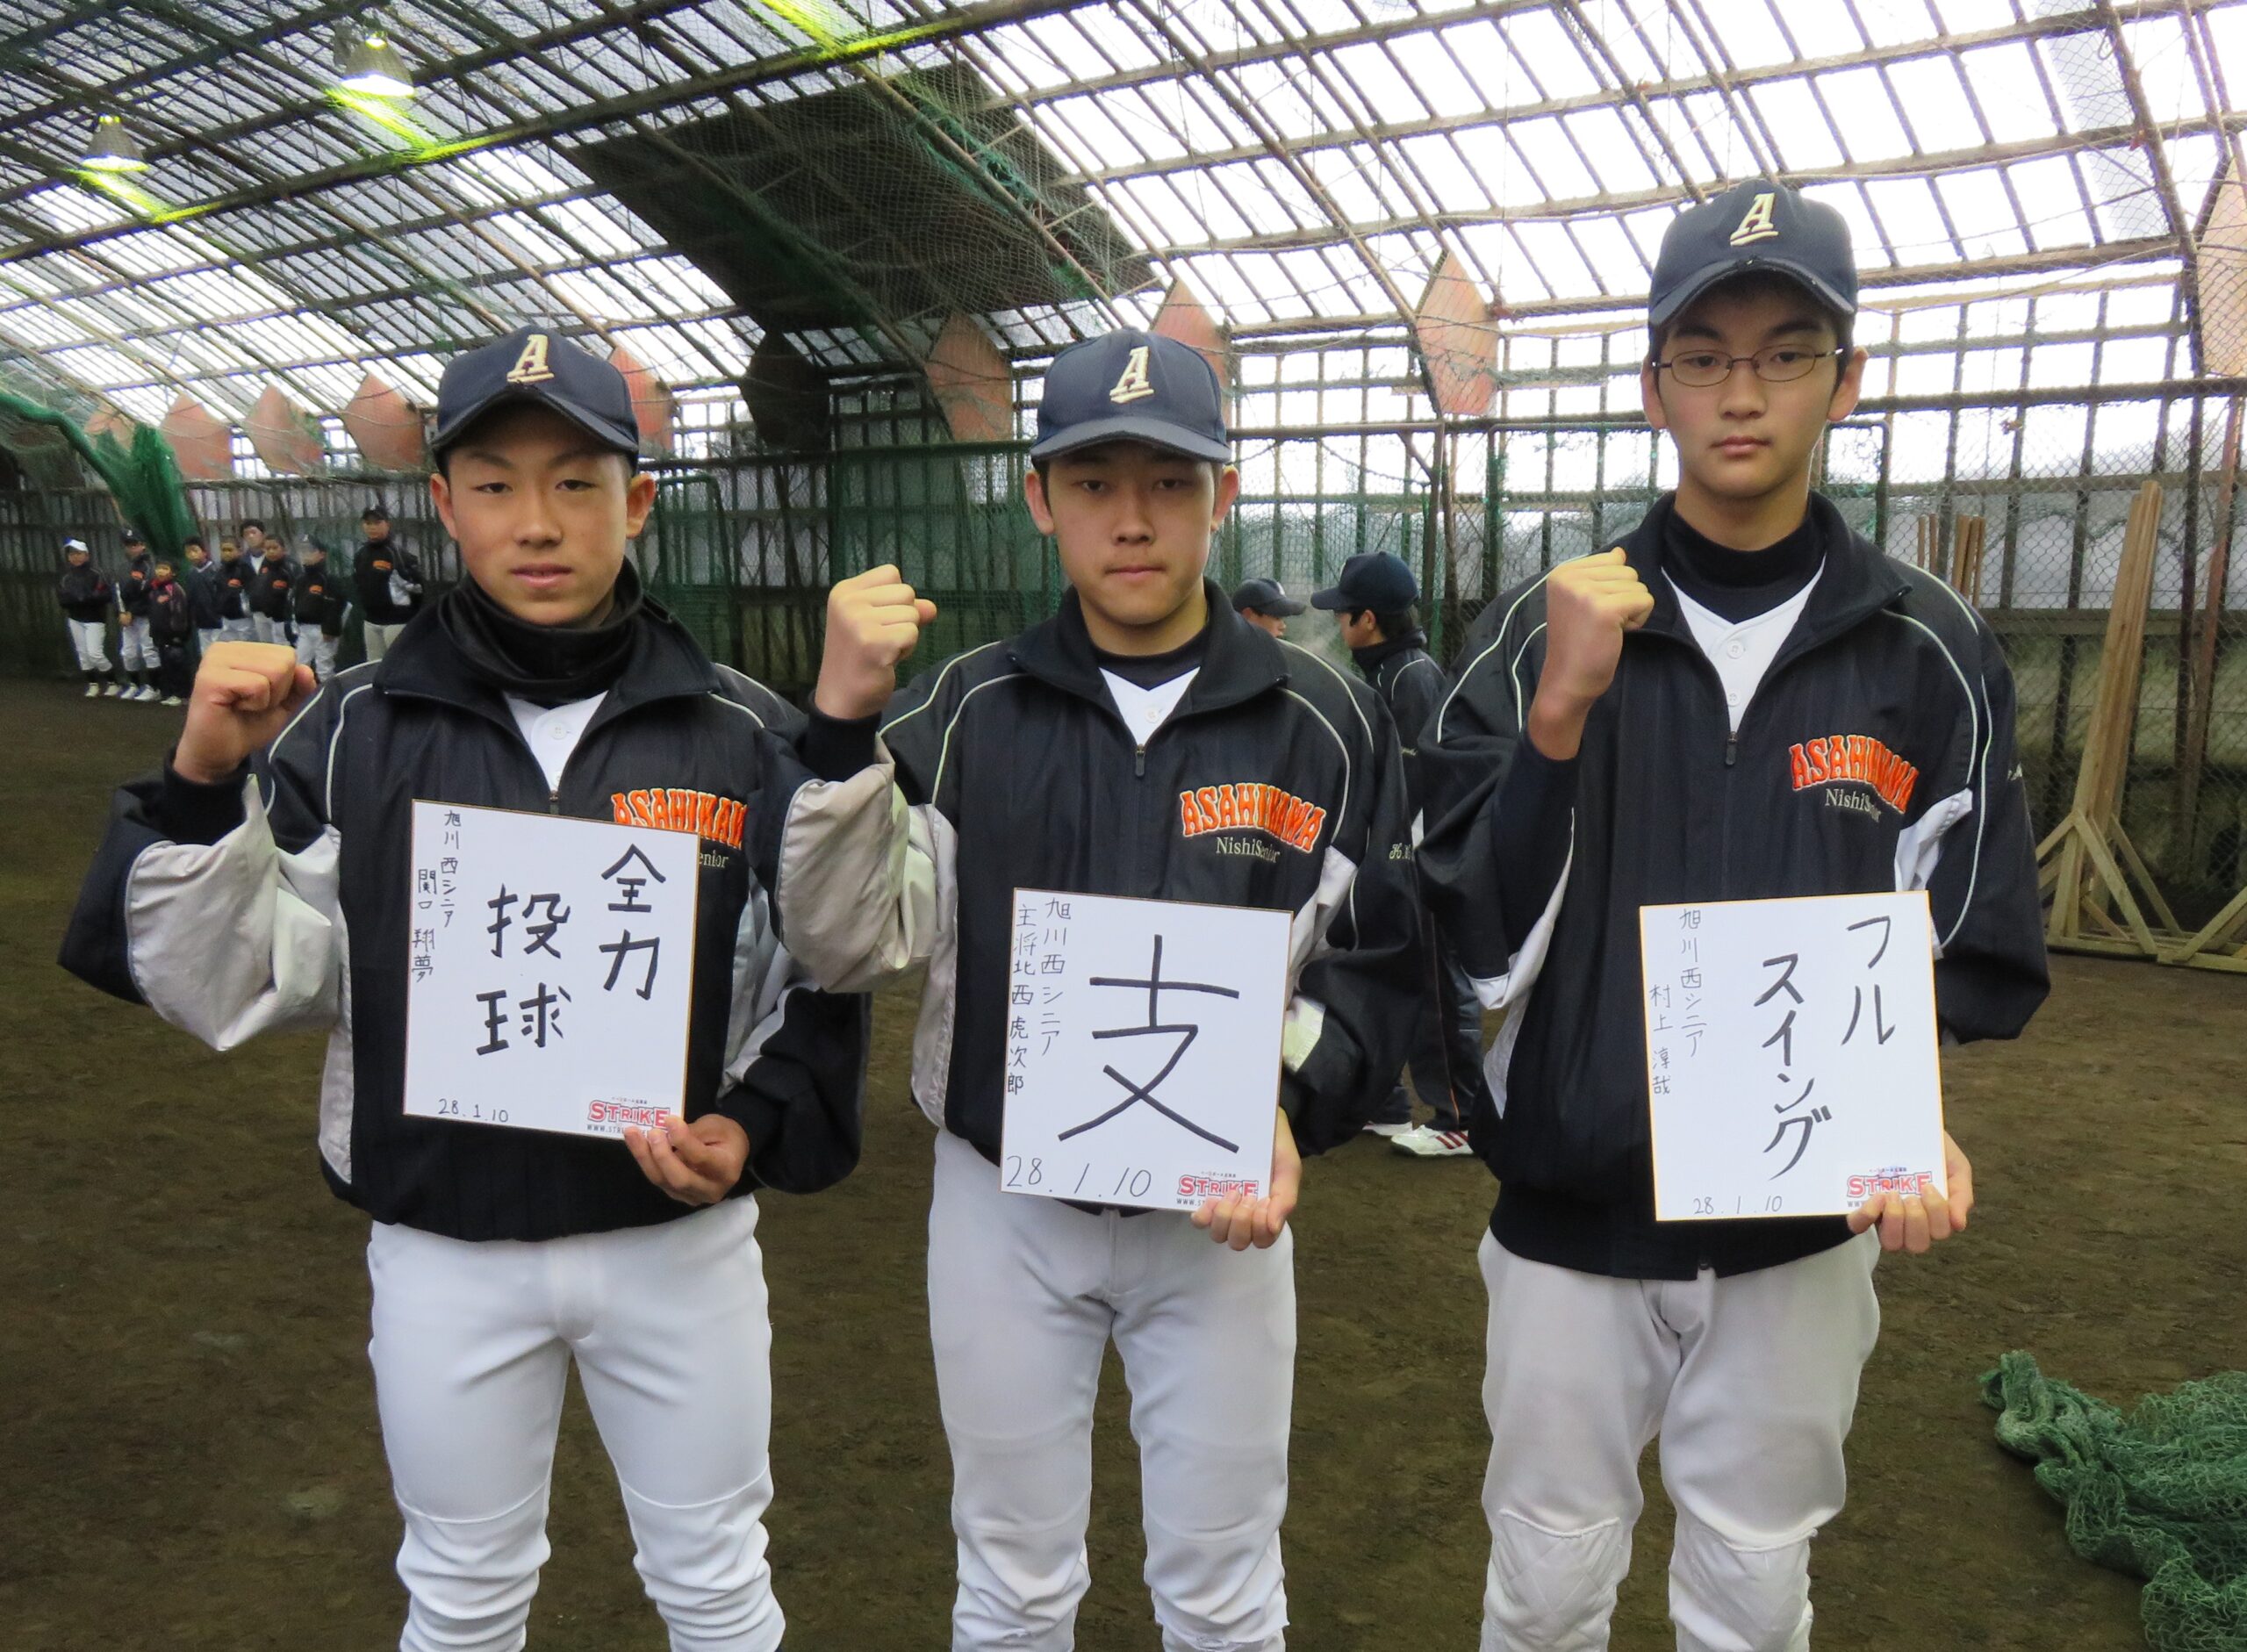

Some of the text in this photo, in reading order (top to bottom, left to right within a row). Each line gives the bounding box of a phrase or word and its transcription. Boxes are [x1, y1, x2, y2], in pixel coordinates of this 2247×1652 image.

[1729, 192, 1779, 247] A
[506, 334, 555, 383] A
[1109, 345, 1155, 404] A
[1180, 782, 1327, 854] ASAHIKAWA
[475, 883, 572, 1057] 投球
[599, 843, 667, 1002] 全力
[1841, 915, 1897, 1046] フル
[1058, 934, 1240, 1154] 支
[1754, 953, 1834, 1182] スイング
[587, 1099, 671, 1130] STRIKE
